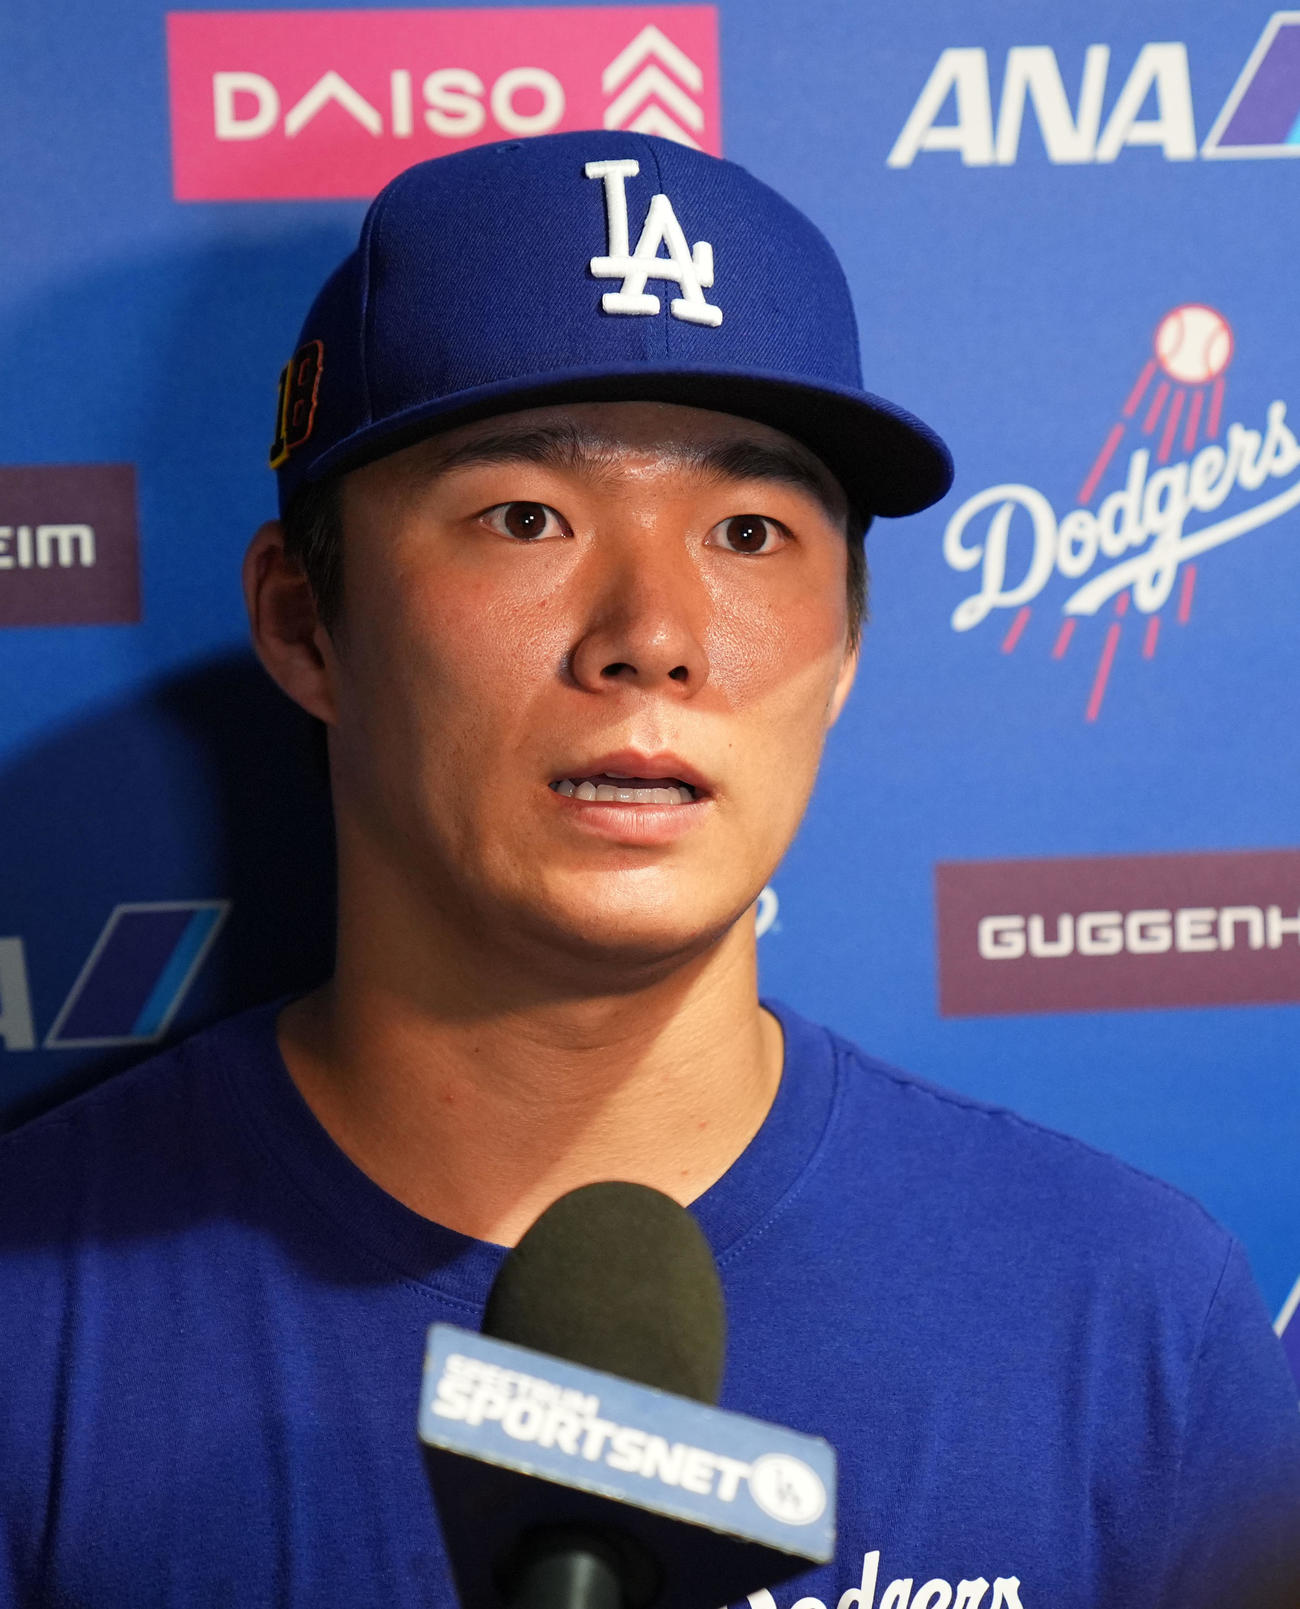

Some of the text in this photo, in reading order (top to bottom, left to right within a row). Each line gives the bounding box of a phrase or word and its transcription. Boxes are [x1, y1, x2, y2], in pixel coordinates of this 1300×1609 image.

[213, 66, 566, 141] DAISO
[886, 42, 1198, 168] ANA
[585, 158, 723, 328] LA
[943, 400, 1300, 632] Dodgers
[978, 904, 1300, 961] GUGGENH
[430, 1370, 752, 1503] SPORTSNET
